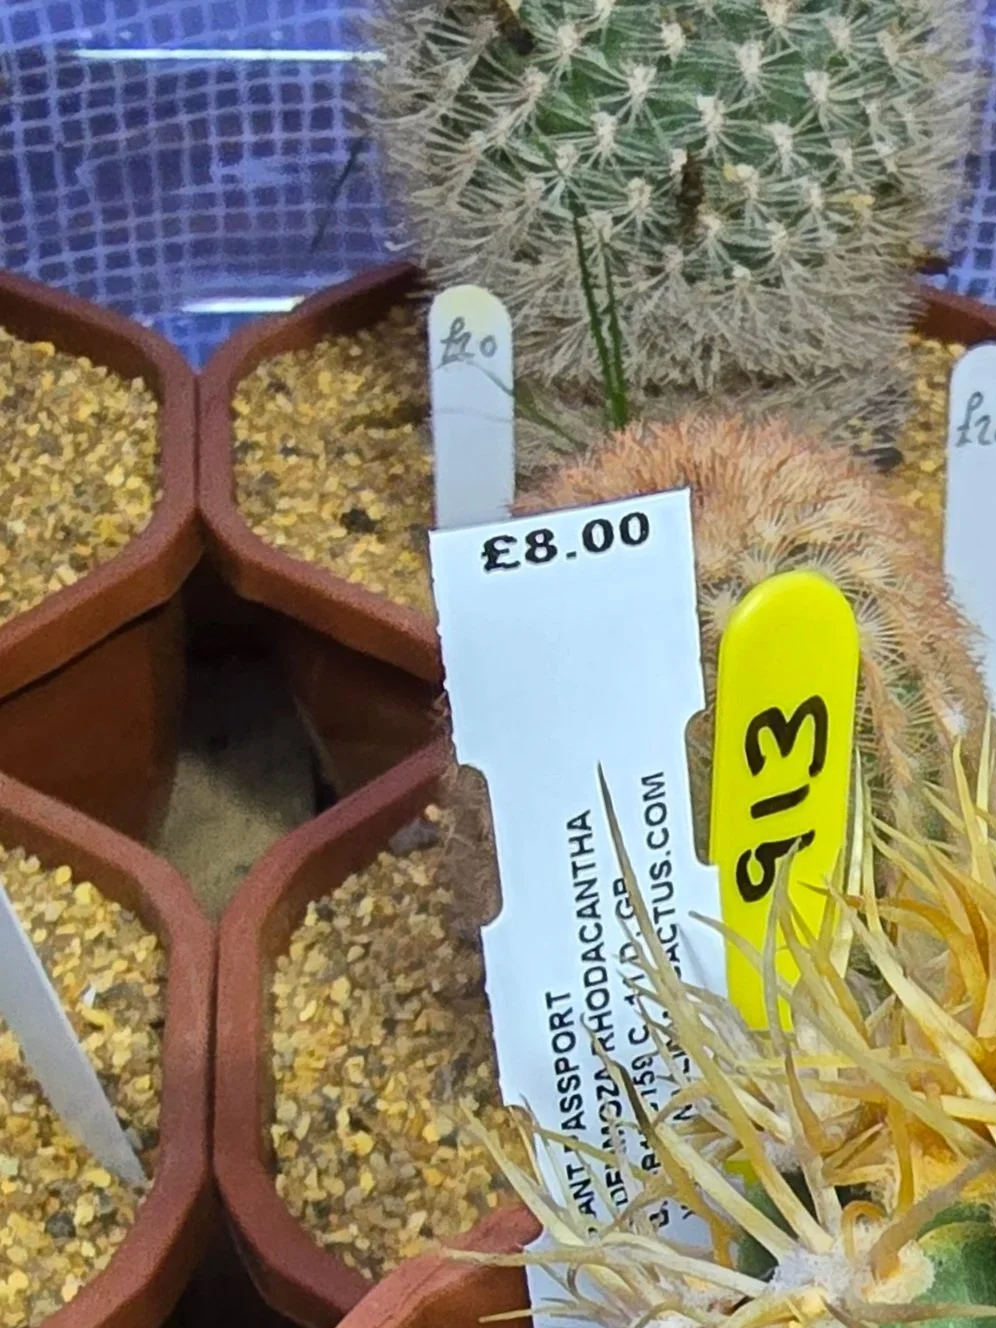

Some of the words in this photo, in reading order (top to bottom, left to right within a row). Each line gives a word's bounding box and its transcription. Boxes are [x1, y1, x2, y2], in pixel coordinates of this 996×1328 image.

[481, 511, 650, 572] £8.00
[735, 695, 829, 904] 913
[566, 809, 616, 1055] RHODACANTHA
